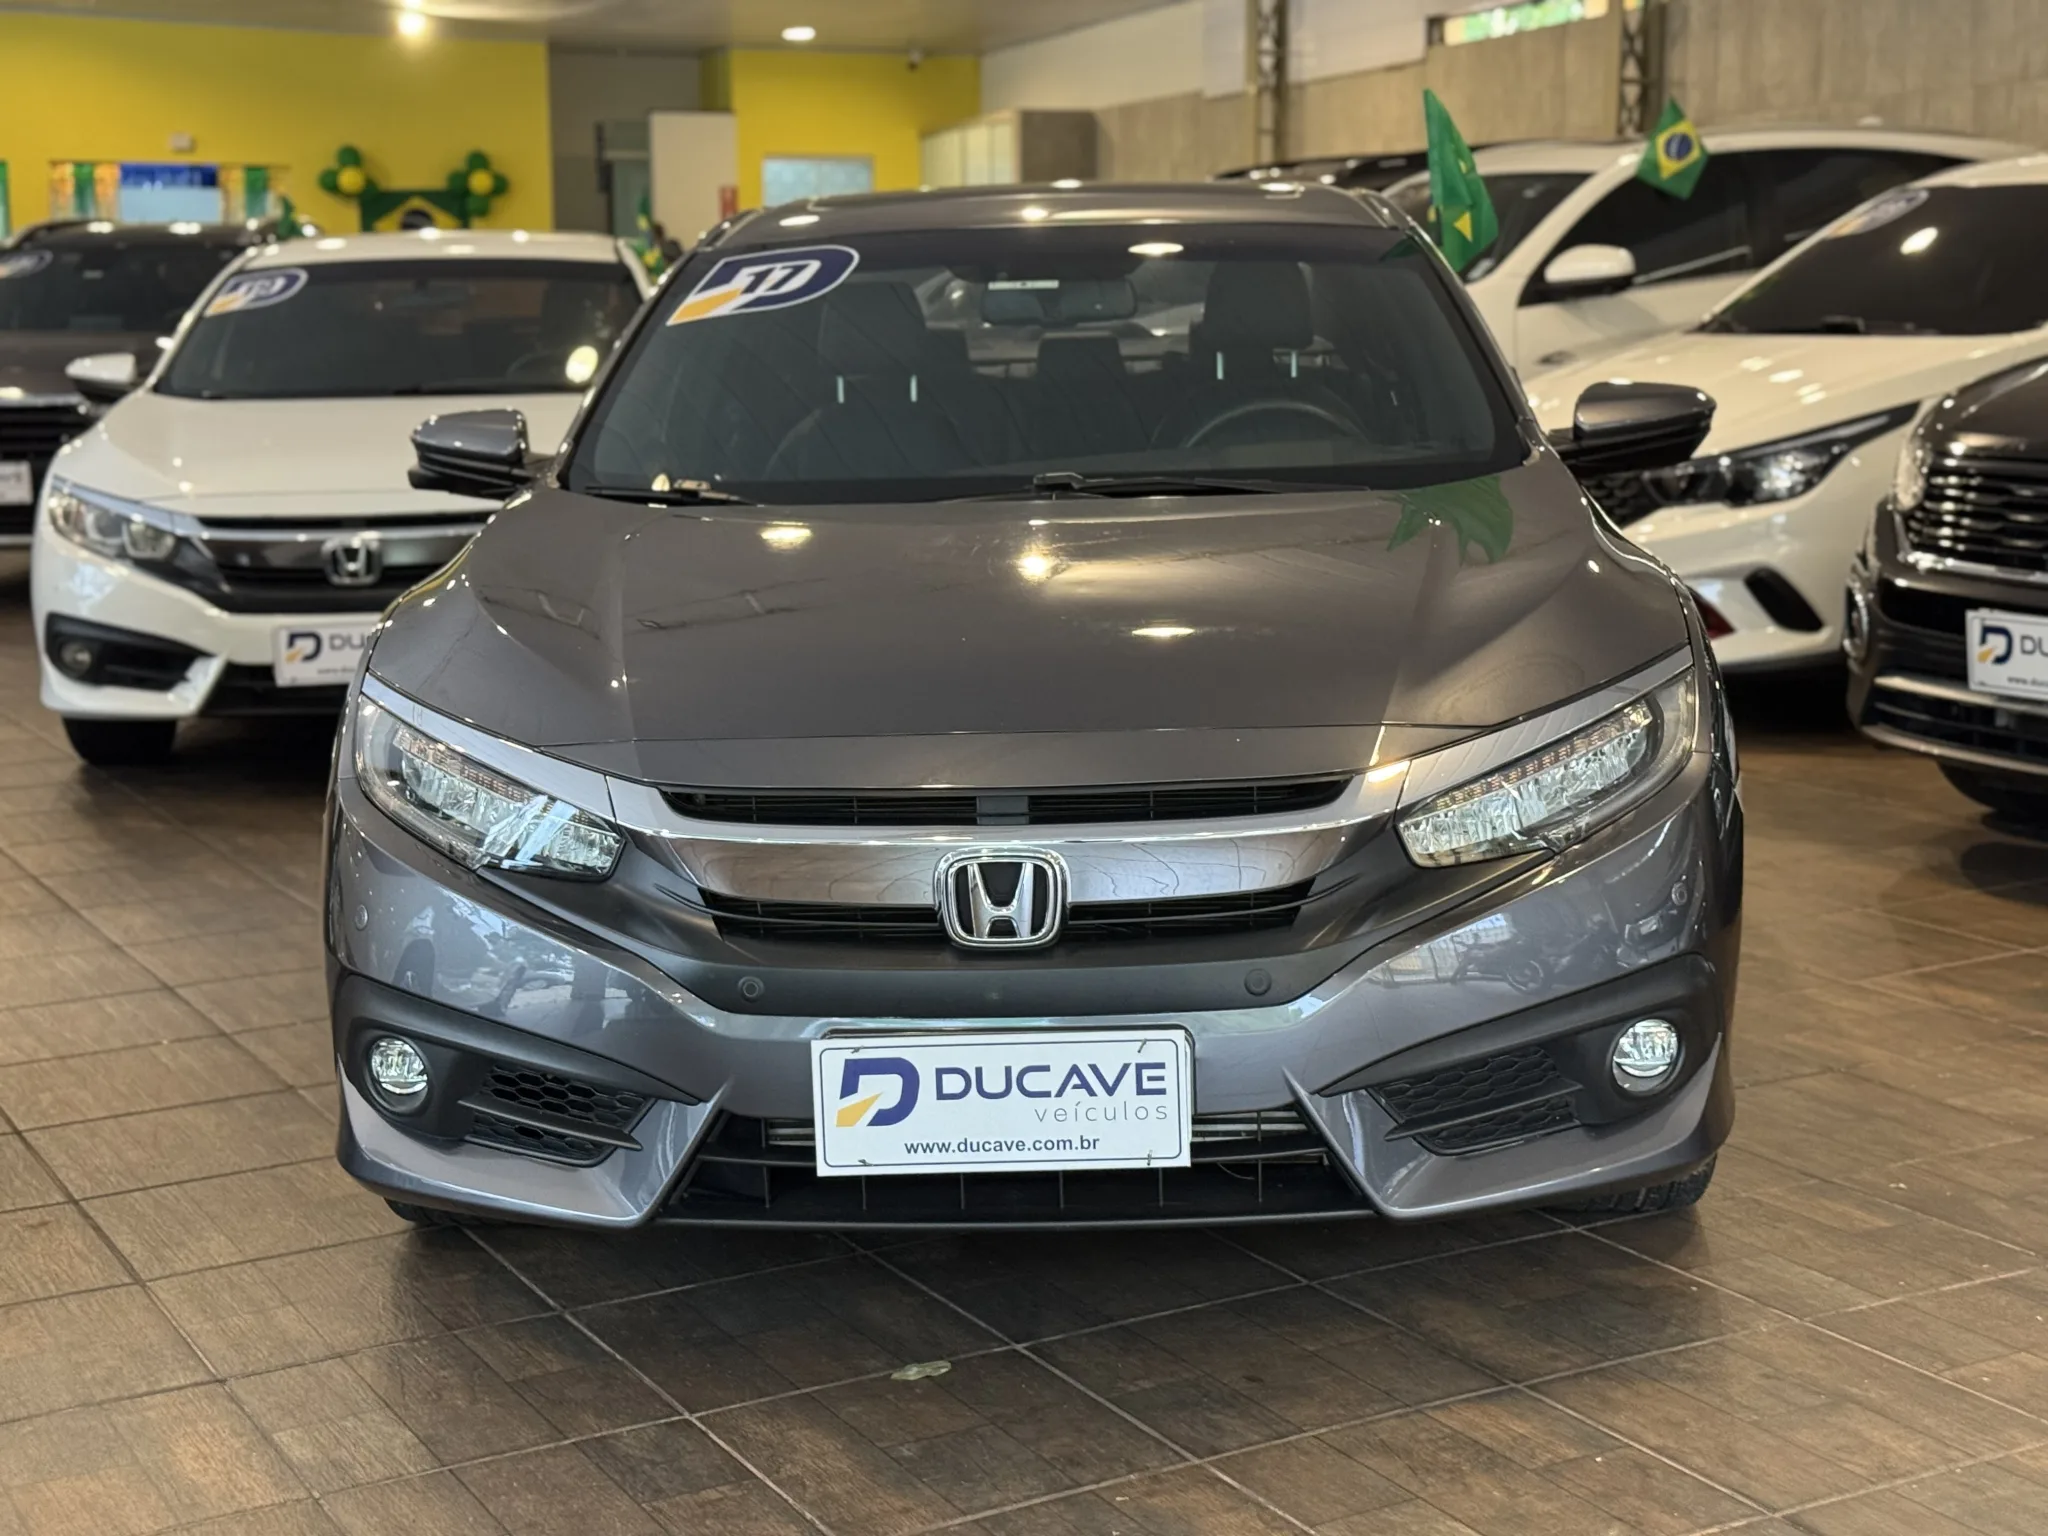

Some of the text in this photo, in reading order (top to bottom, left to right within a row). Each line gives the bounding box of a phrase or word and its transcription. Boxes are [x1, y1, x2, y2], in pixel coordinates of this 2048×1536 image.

[934, 1062, 1167, 1101] DUCAVE
[1034, 1100, 1168, 1123] veículos
[904, 1135, 1100, 1155] www.ducave.com.br
